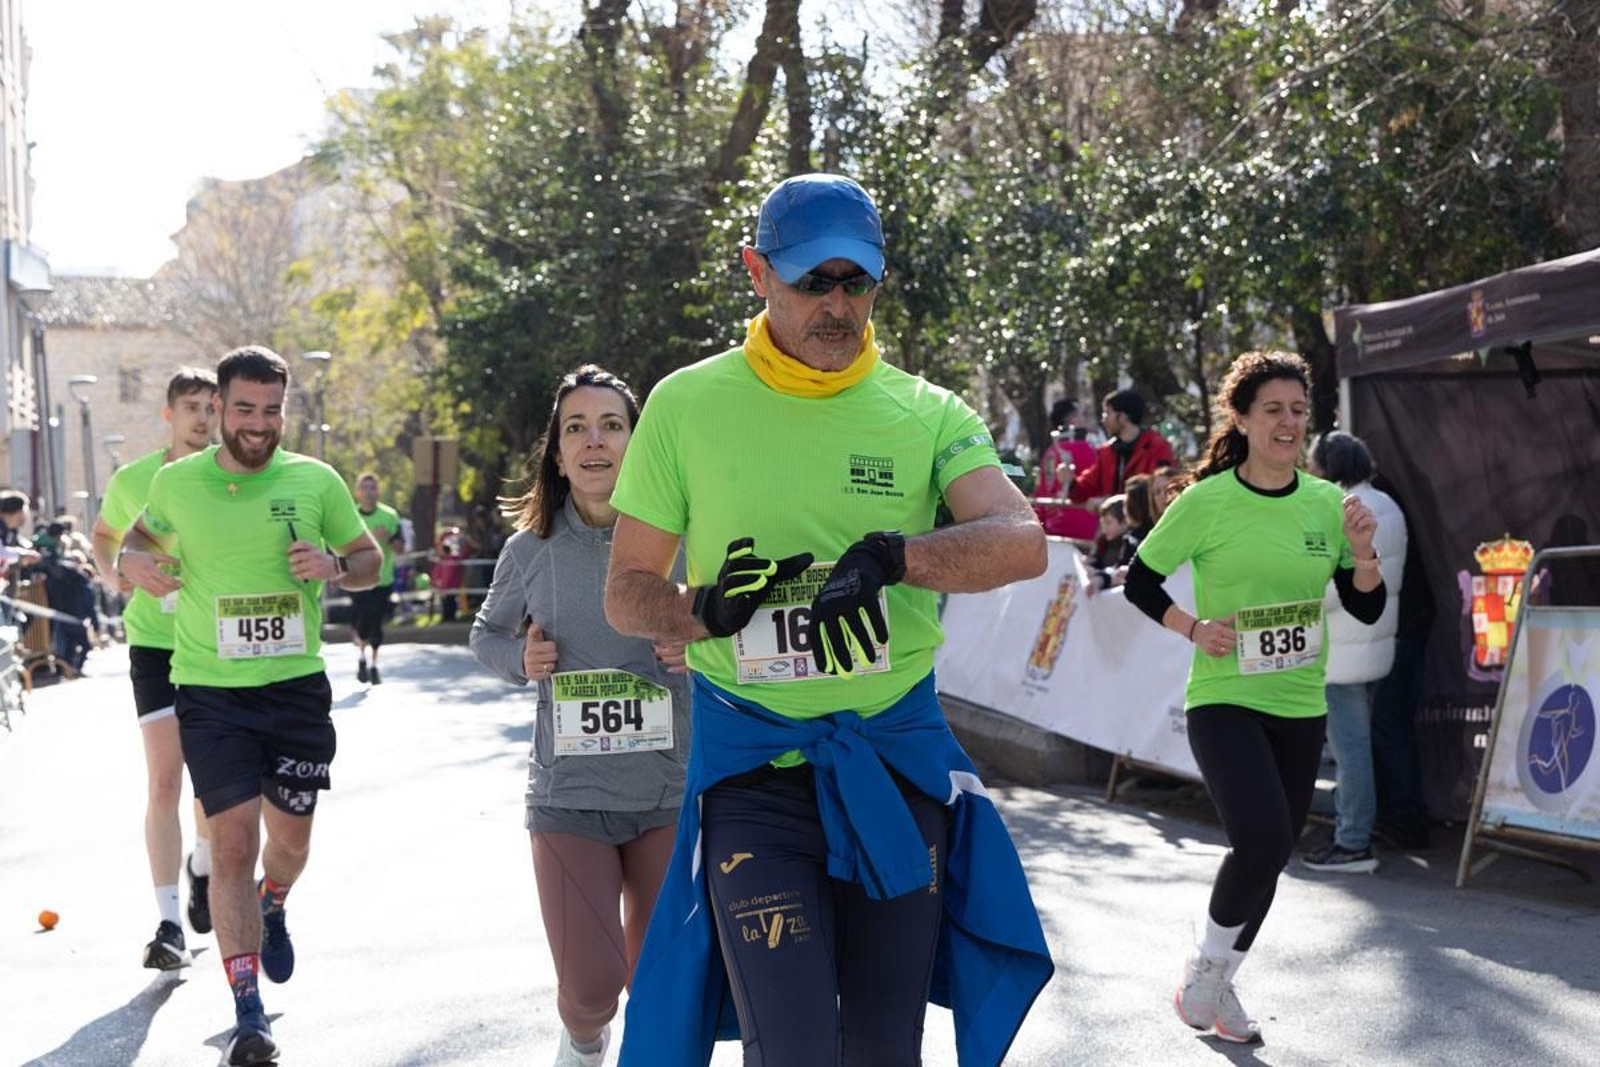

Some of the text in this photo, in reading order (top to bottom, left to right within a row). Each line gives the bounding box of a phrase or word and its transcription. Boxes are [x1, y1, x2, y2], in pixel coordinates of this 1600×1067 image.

[885, 490, 905, 498] Bosco
[791, 584, 822, 603] POPUL
[238, 617, 285, 642] 458
[772, 607, 813, 654] 16
[1260, 626, 1306, 657] 836
[574, 674, 588, 685] SAN
[591, 673, 609, 684] JUAN
[611, 672, 634, 684] BOSCO
[571, 686, 597, 697] CARRERA
[600, 683, 628, 697] POPULAR
[581, 699, 644, 735] 564
[729, 898, 749, 911] club
[742, 924, 761, 942] la
